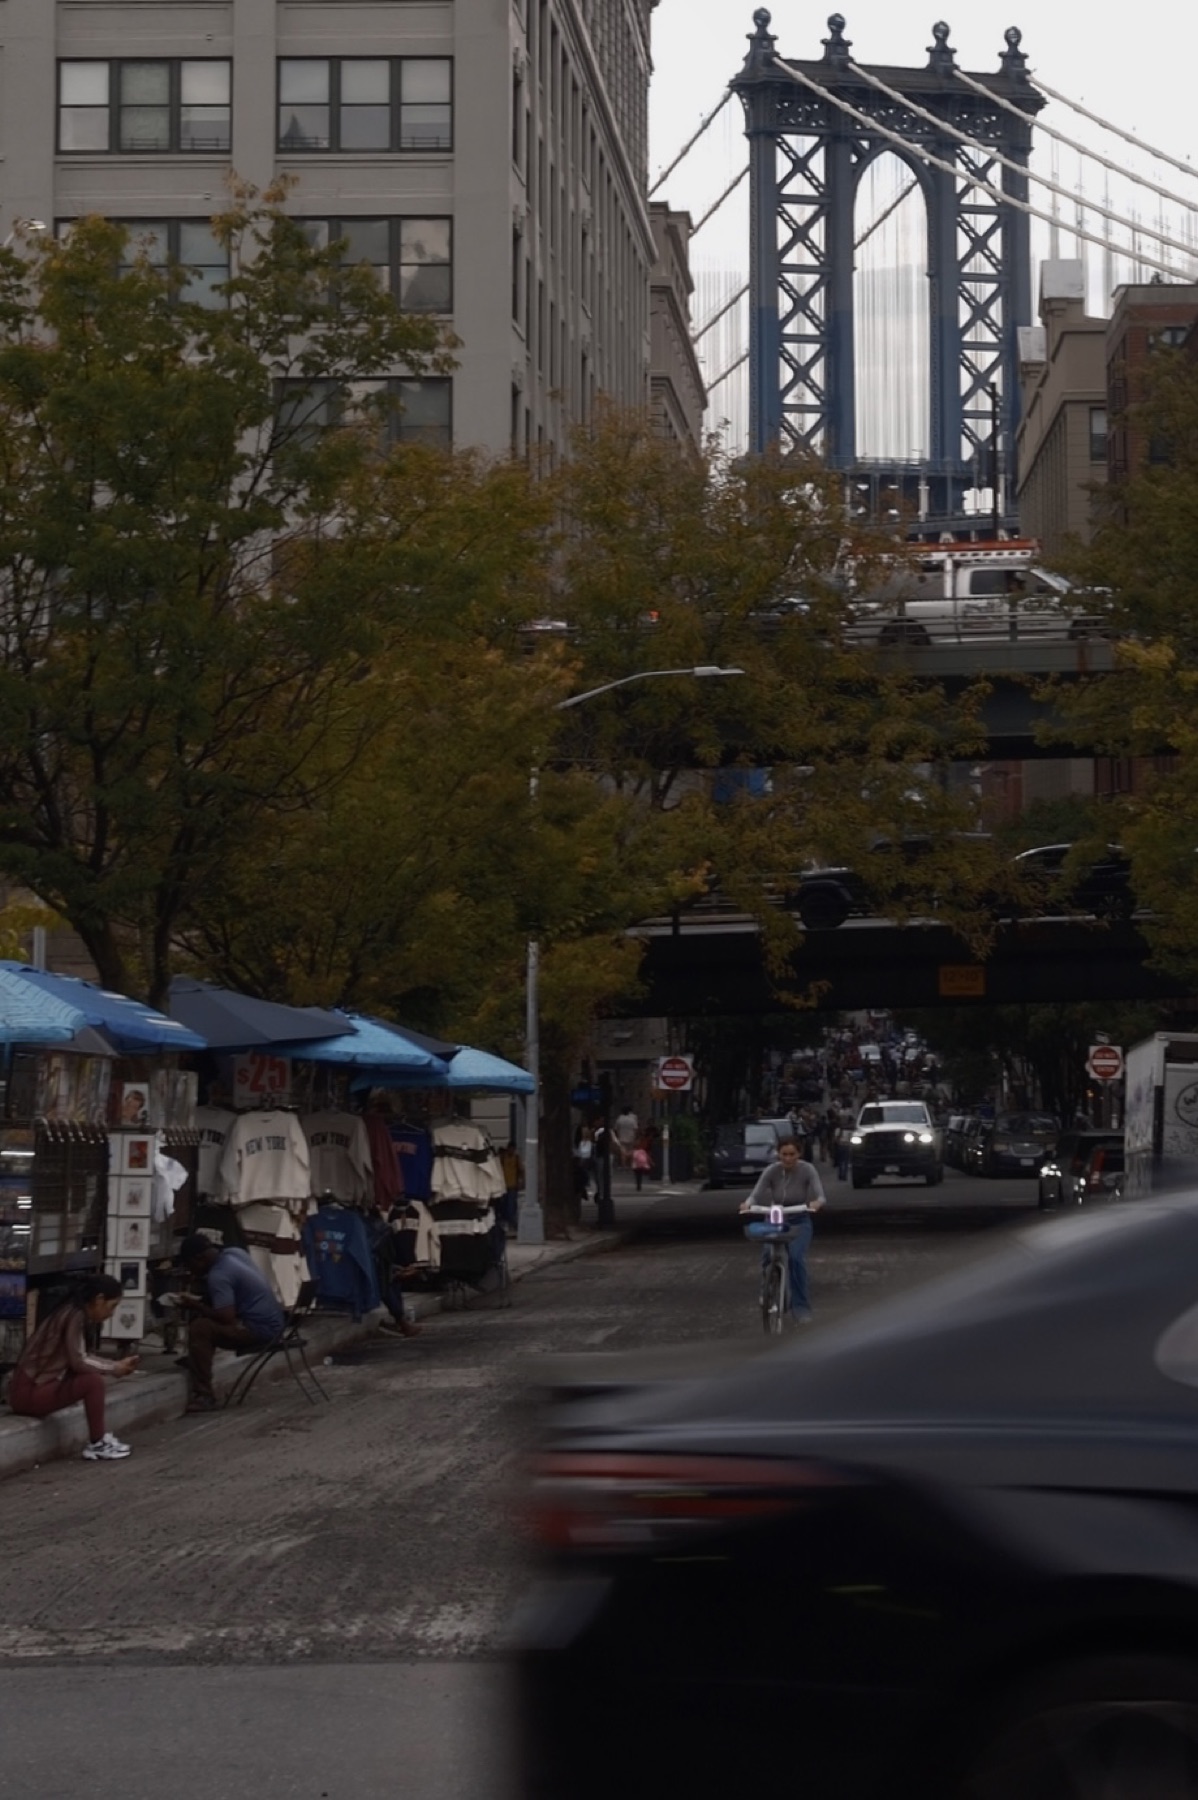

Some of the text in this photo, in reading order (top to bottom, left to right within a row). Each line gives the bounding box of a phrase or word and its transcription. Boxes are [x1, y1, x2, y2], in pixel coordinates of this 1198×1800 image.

[237, 1053, 287, 1092] $25
[245, 1135, 286, 1155] NEW YORK
[310, 1131, 350, 1149] NEW YORK
